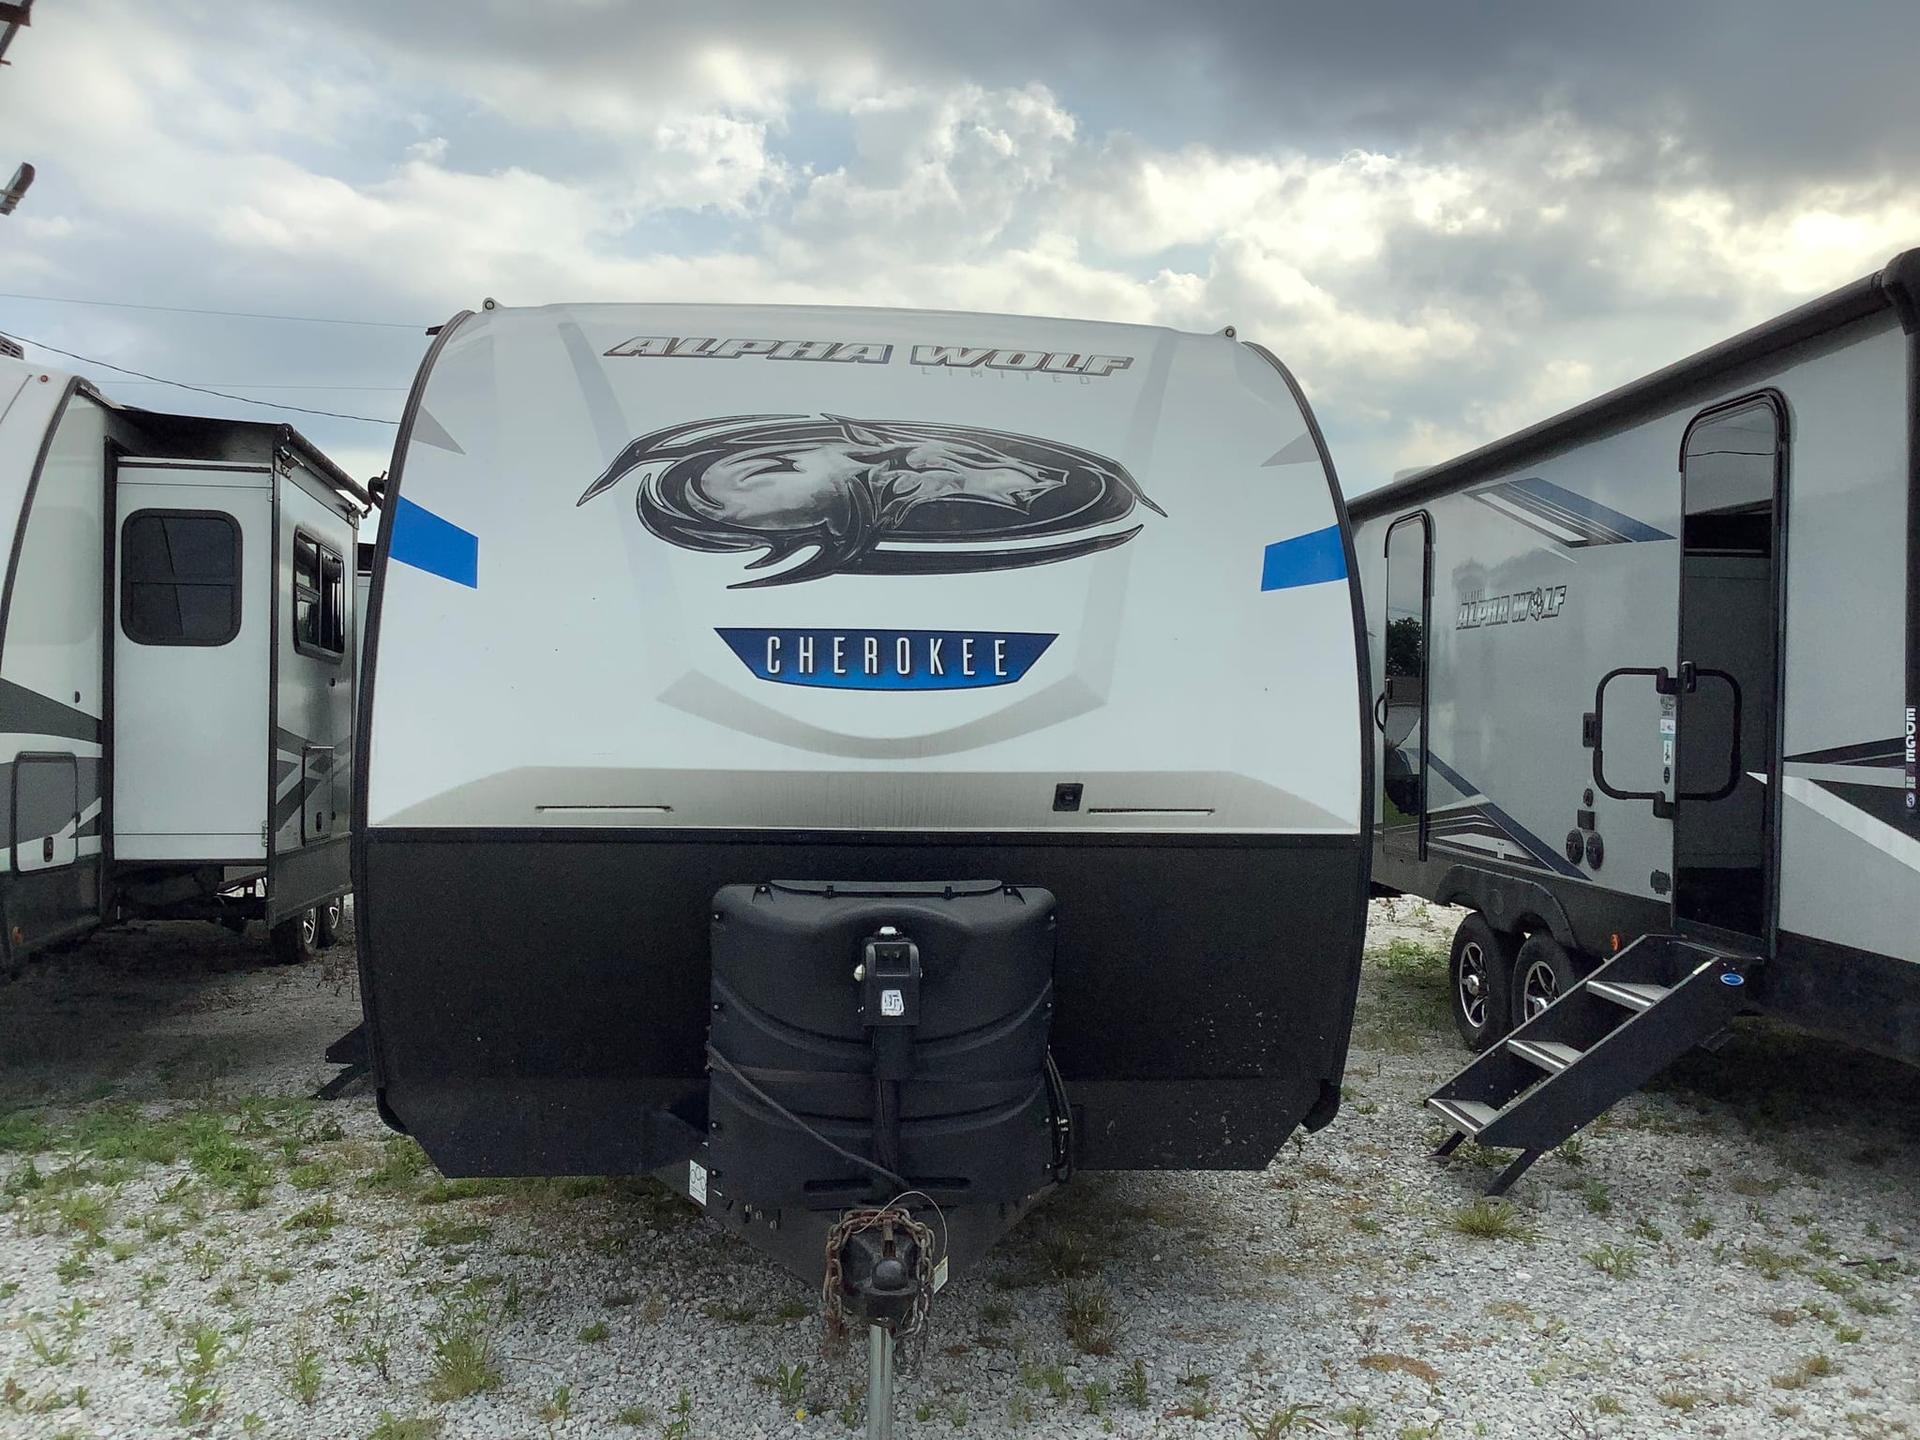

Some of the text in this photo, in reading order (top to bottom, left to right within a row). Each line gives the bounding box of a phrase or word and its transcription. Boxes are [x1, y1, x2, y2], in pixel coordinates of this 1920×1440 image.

[603, 336, 1134, 377] ALPHA WOLF
[921, 367, 1091, 385] LIMITED
[1456, 596, 1509, 630] ALPHA
[766, 636, 1008, 676] CHEROKEE
